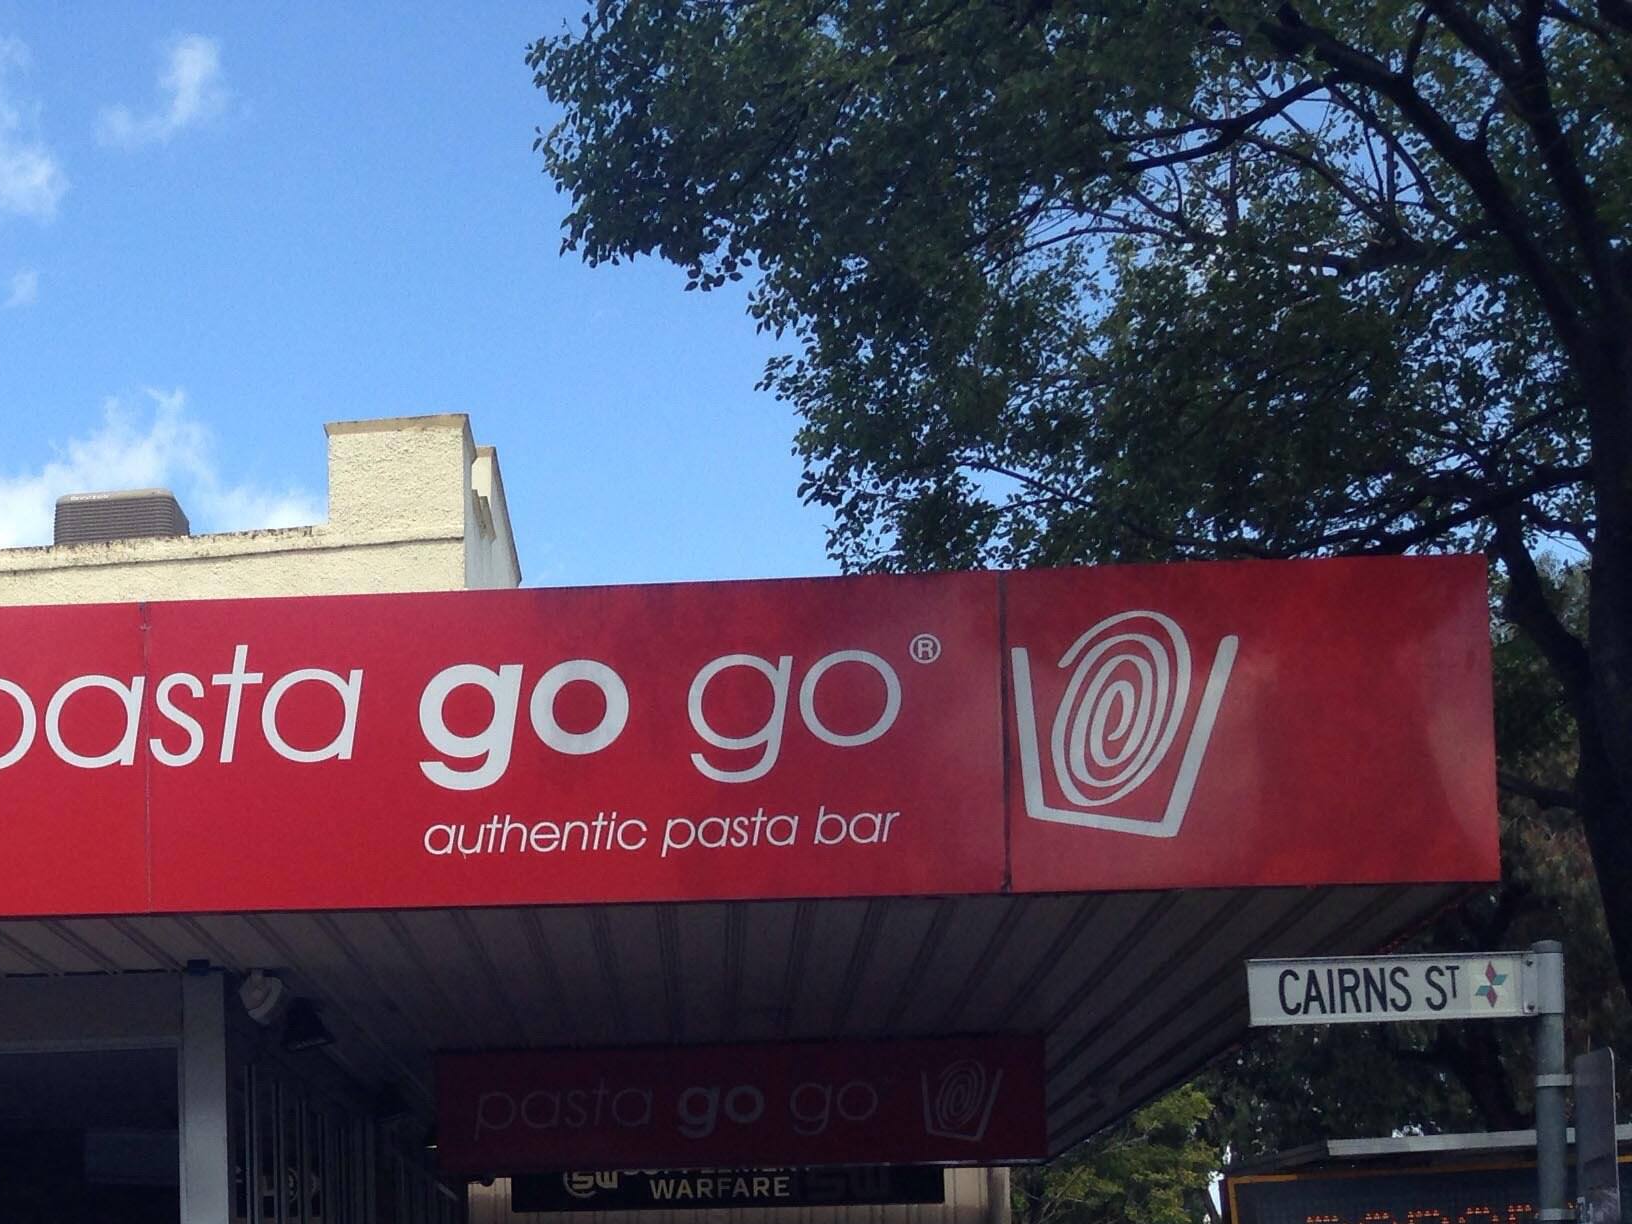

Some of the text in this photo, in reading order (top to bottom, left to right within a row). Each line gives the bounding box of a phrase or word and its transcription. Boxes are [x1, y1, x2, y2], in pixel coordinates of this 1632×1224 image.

[419, 660, 629, 791] go
[424, 806, 900, 857] authentic pasta bar
[1279, 965, 1460, 1015] CAIRNS ST
[474, 1077, 654, 1142] pasta
[679, 1084, 765, 1138] go
[649, 1176, 791, 1200] WARFARE
